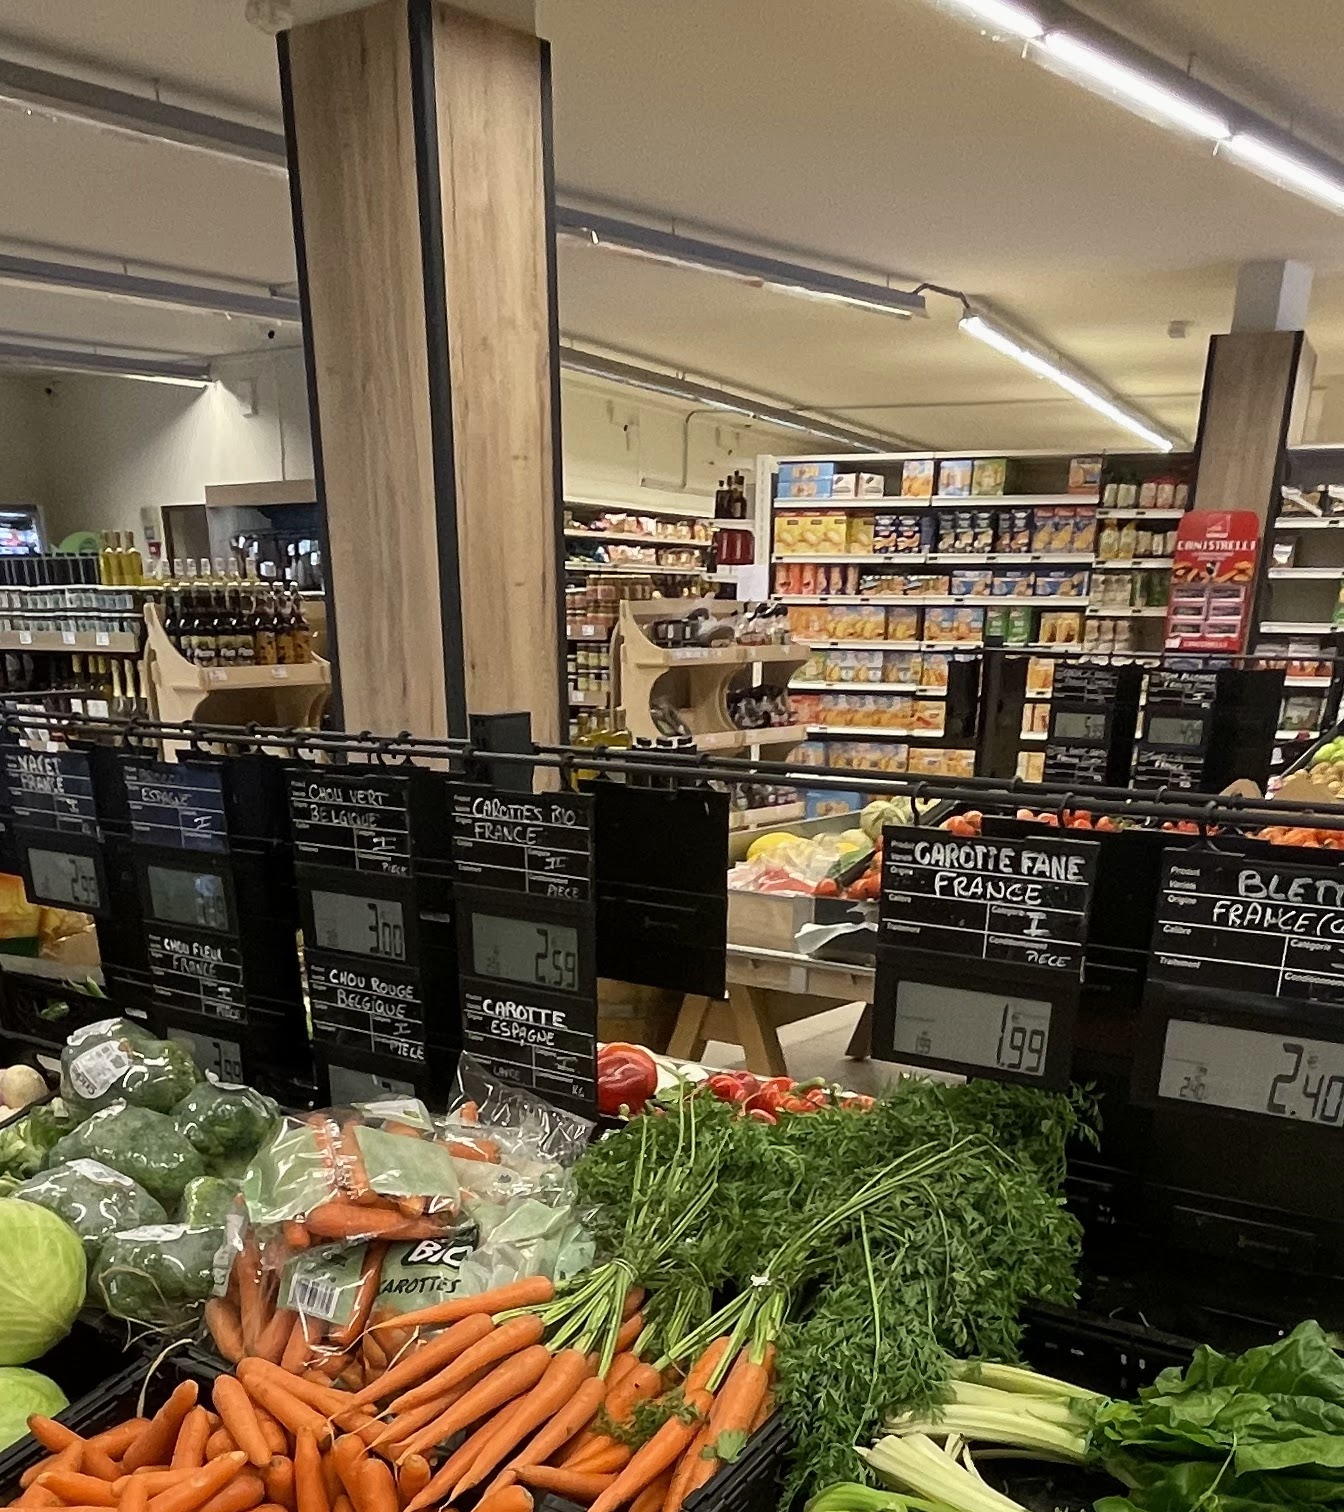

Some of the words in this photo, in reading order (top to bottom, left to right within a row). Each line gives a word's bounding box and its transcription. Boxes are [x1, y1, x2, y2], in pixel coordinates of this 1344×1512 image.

[308, 784, 344, 802] CHOU
[349, 789, 390, 808] VERT
[310, 804, 381, 828] BELGIQUE
[472, 797, 544, 822] CAROTTES
[550, 805, 576, 826] BIO
[474, 822, 544, 845] FRANCE
[914, 841, 1016, 873] CAROTTE
[1021, 851, 1086, 881] FANE
[934, 872, 1044, 905] FRANCE
[1212, 900, 1317, 932] FRANCE
[329, 969, 366, 988] CHOU
[371, 977, 414, 999] ROUGE
[337, 989, 407, 1018] BELGIQUE
[482, 999, 568, 1031] CAROTTE
[490, 1020, 555, 1046] ESPAGNE
[996, 1003, 1046, 1073] 1.99
[380, 1276, 462, 1295] AROTTES
